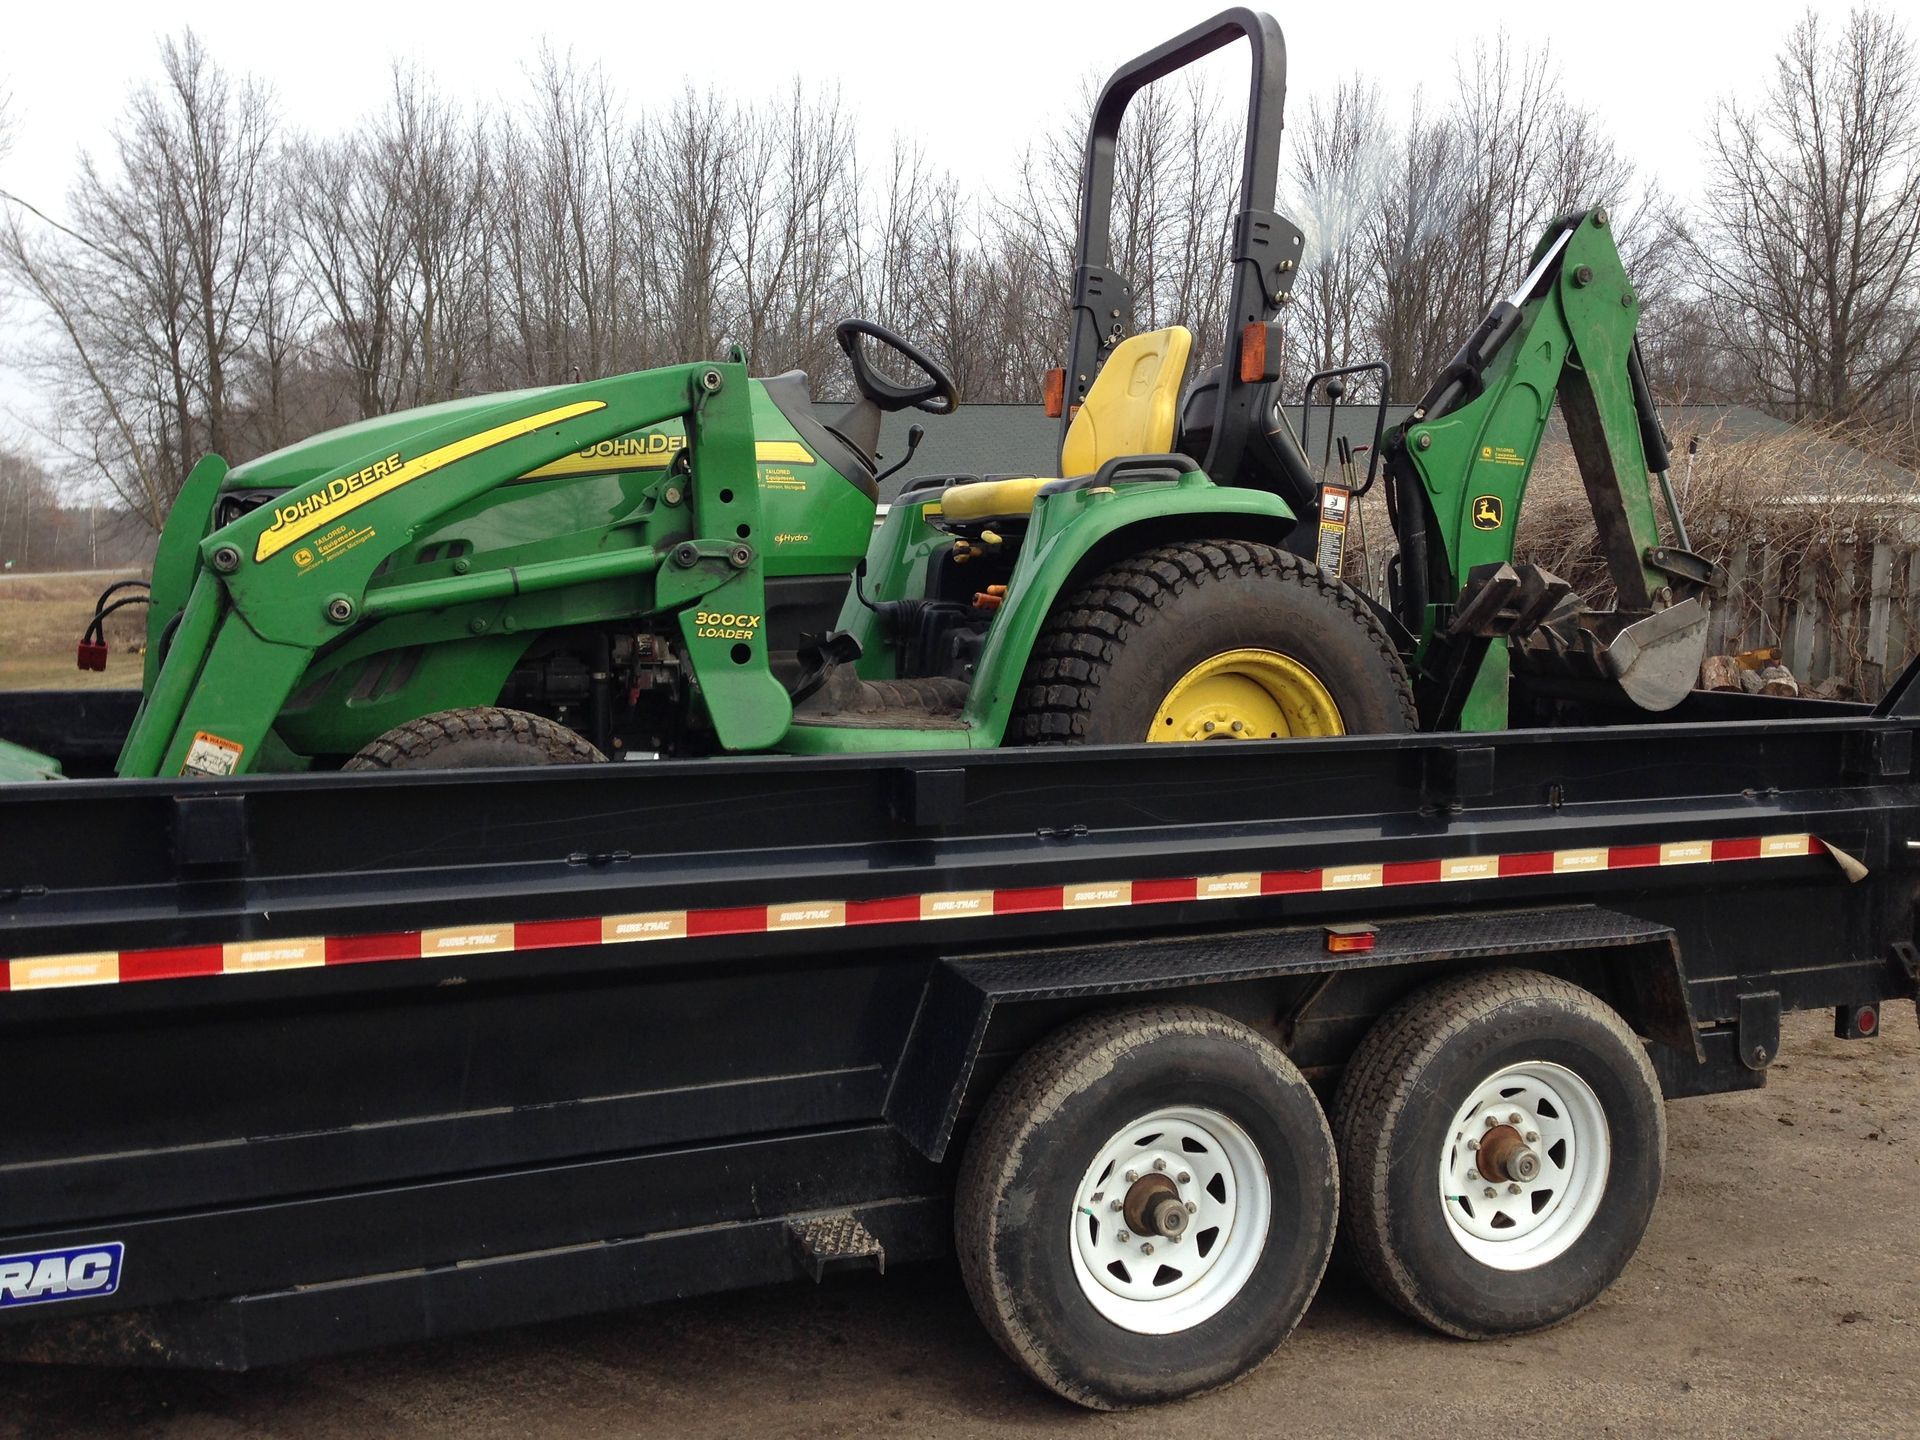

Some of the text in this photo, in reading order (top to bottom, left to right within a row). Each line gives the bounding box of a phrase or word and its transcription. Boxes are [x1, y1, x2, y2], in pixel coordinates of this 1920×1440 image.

[270, 453, 403, 532] JOHN DEERE
[313, 525, 347, 546] TAILORED
[318, 528, 357, 553] Equipment
[695, 612, 760, 628] 300CX
[698, 628, 753, 639] LOADER
[933, 899, 979, 911] SURE-TRAC
[779, 909, 830, 922] SURE-TRAC
[616, 920, 670, 934] SURE-TRAC
